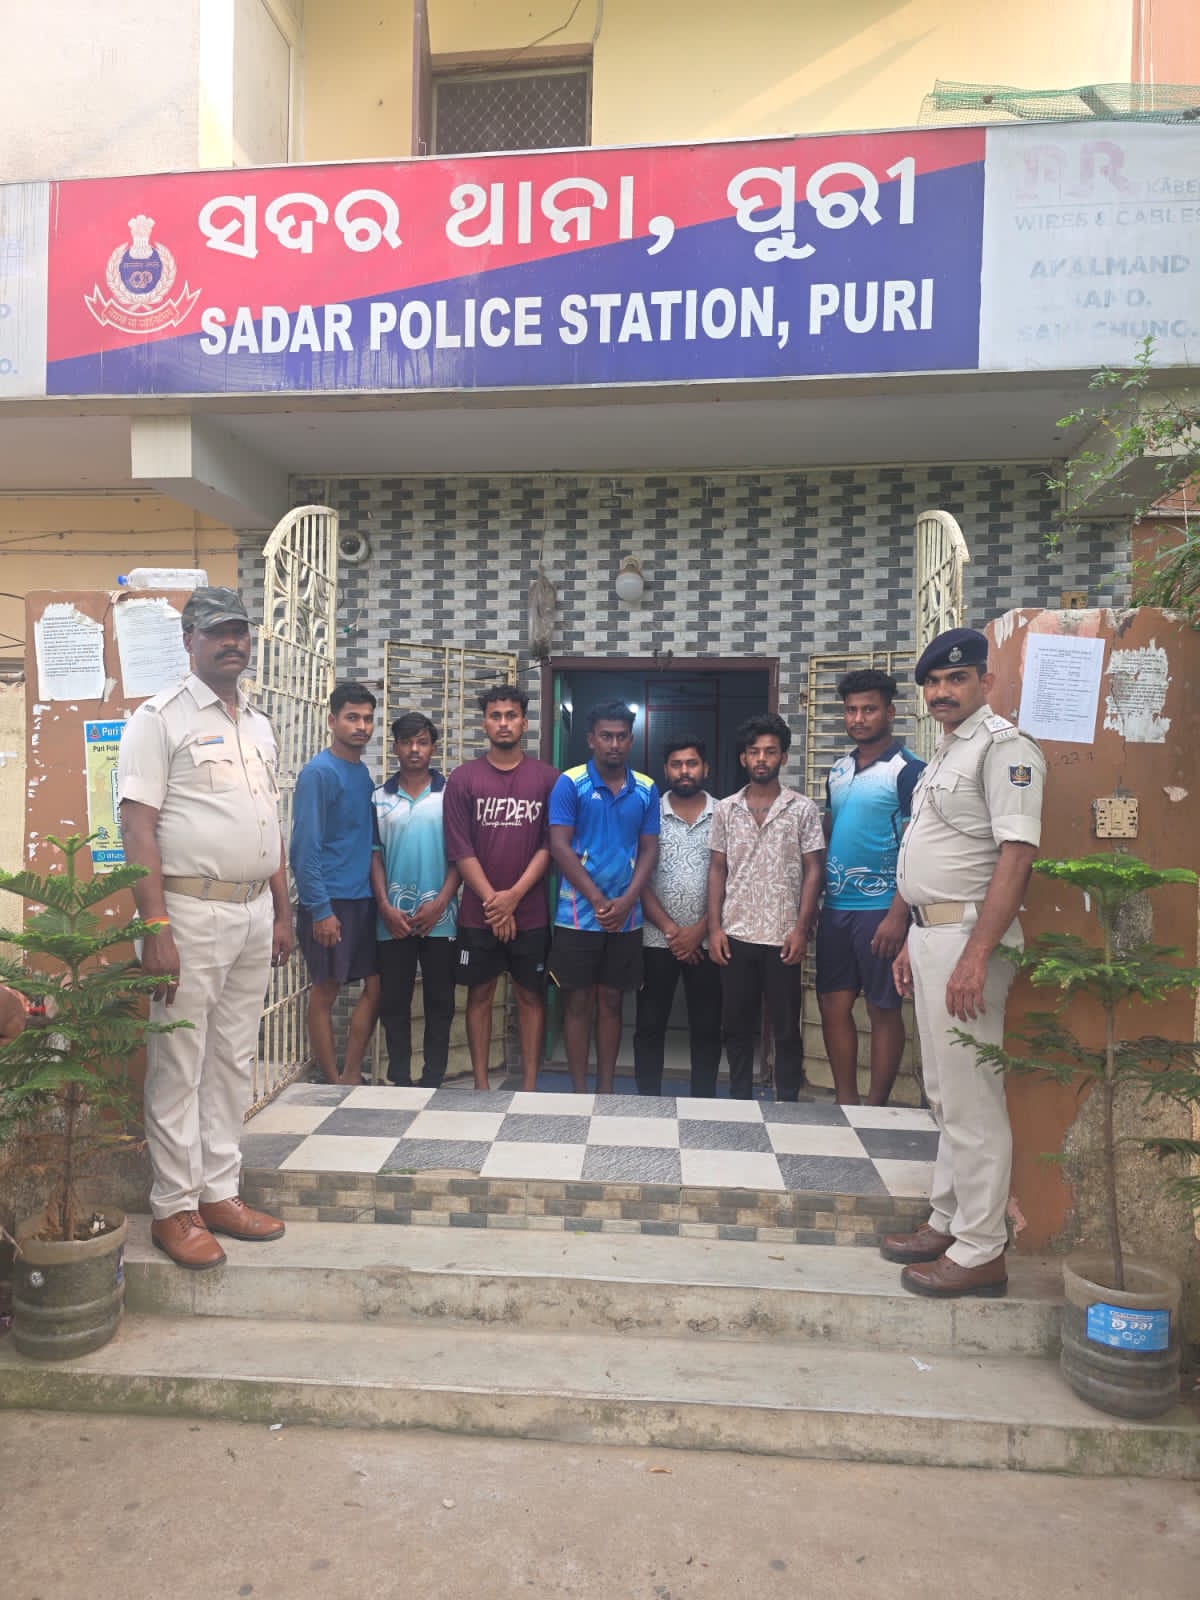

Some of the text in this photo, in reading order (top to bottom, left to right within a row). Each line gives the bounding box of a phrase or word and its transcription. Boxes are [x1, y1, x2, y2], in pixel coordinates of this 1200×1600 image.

[199, 156, 916, 263] ସଦର ଥାନା, ପୁରୀ
[199, 278, 934, 356] SADAR POLICE STATION, PURI
[102, 726, 119, 737] Puri
